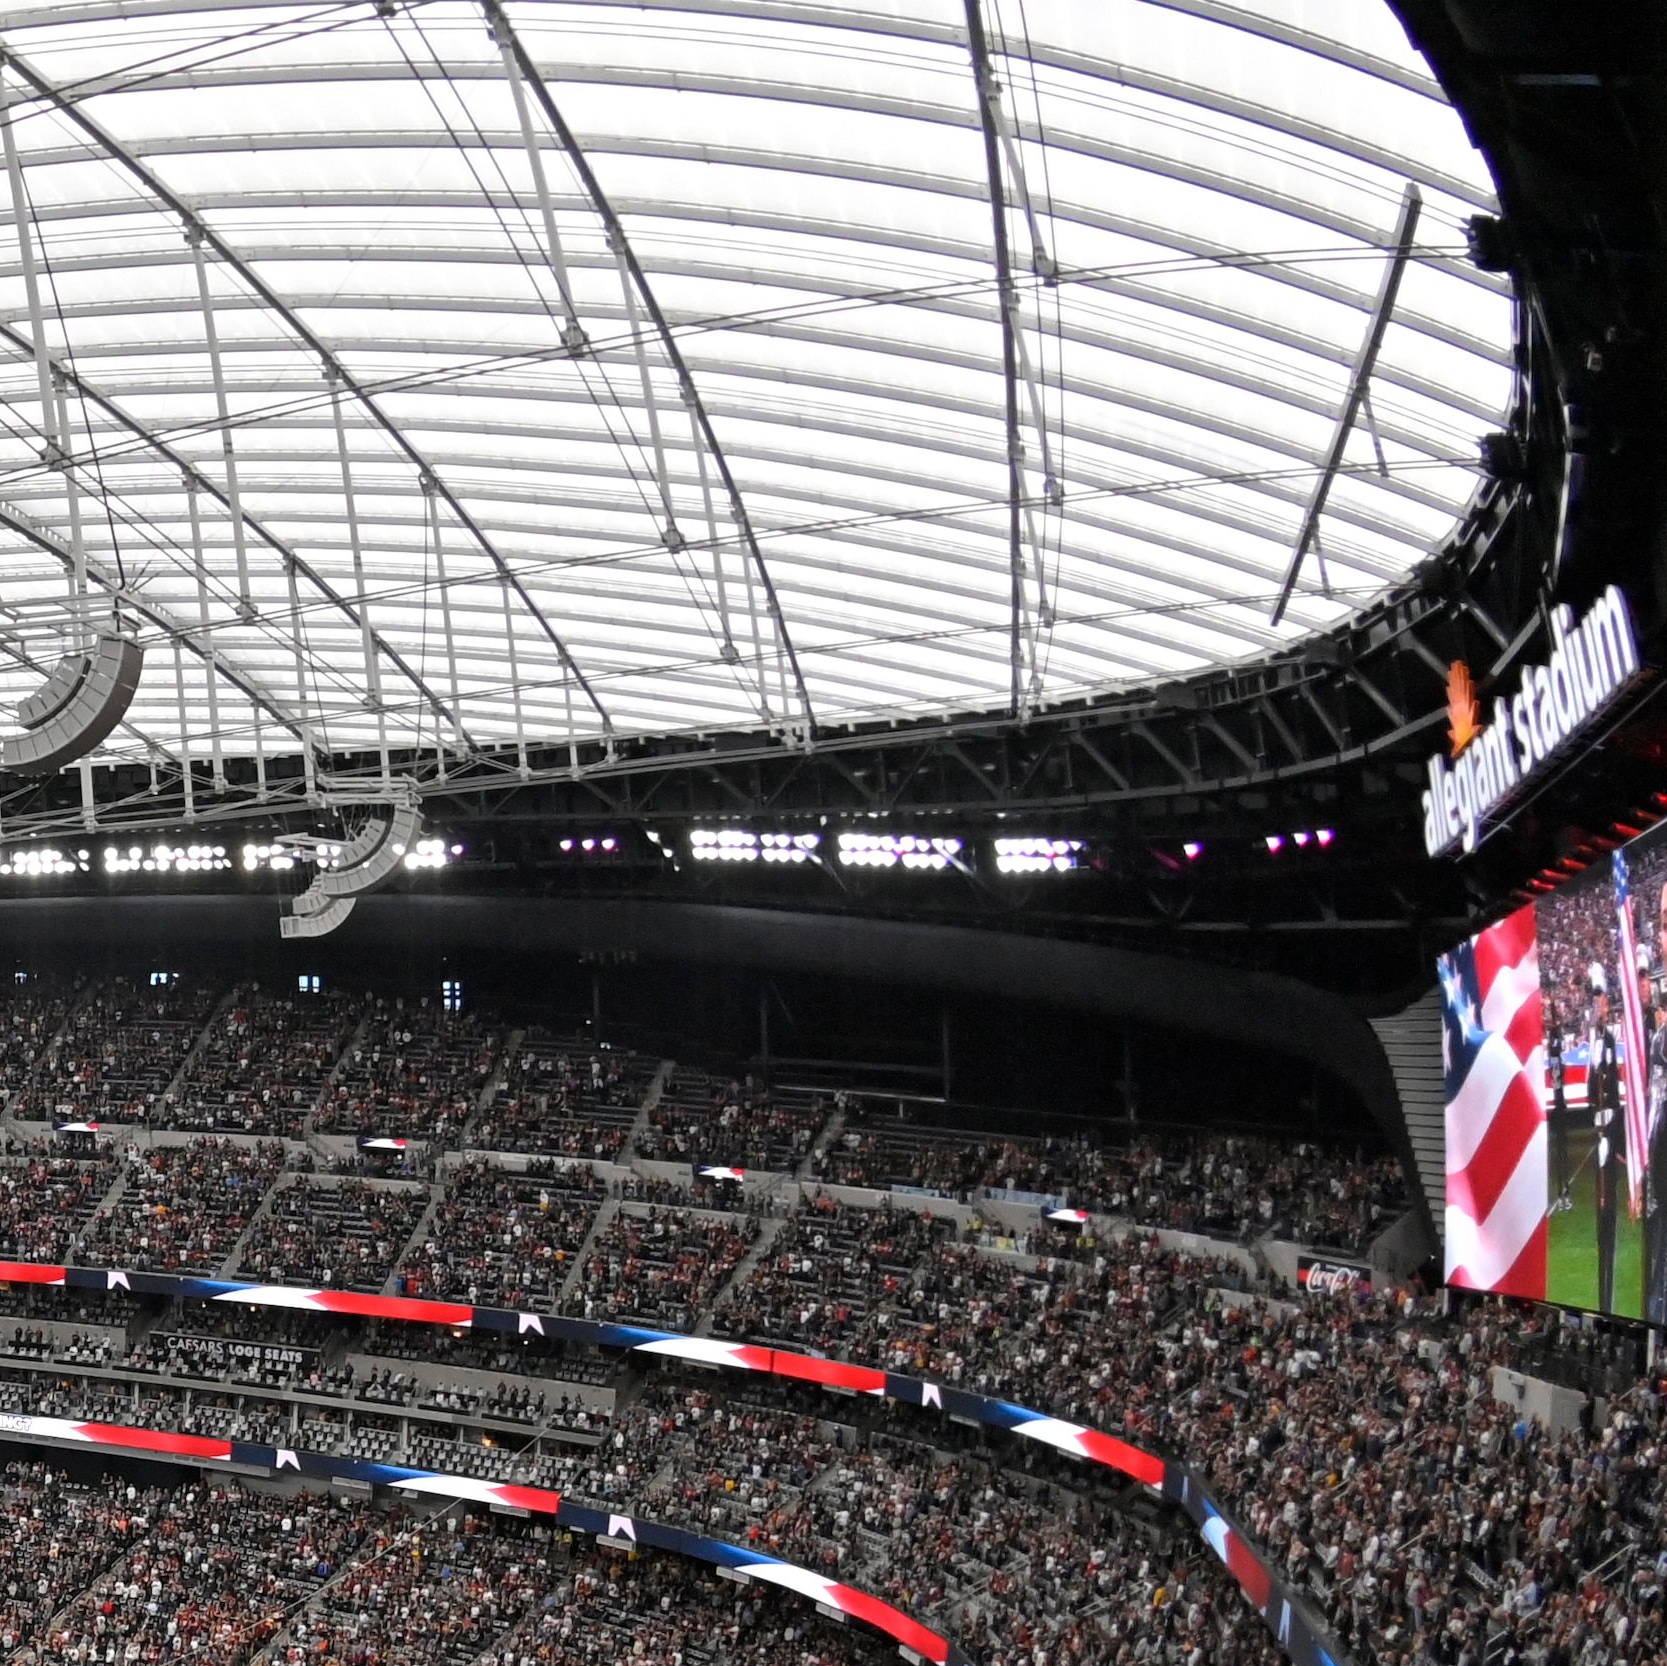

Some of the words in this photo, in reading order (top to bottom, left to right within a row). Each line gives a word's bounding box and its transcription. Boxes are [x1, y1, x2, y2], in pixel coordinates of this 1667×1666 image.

[1422, 696, 1517, 858] allegiant
[1513, 584, 1639, 774] stadium
[167, 1337, 223, 1353] CAESARS
[229, 1344, 260, 1358] LOGE
[265, 1349, 303, 1363] SEATS
